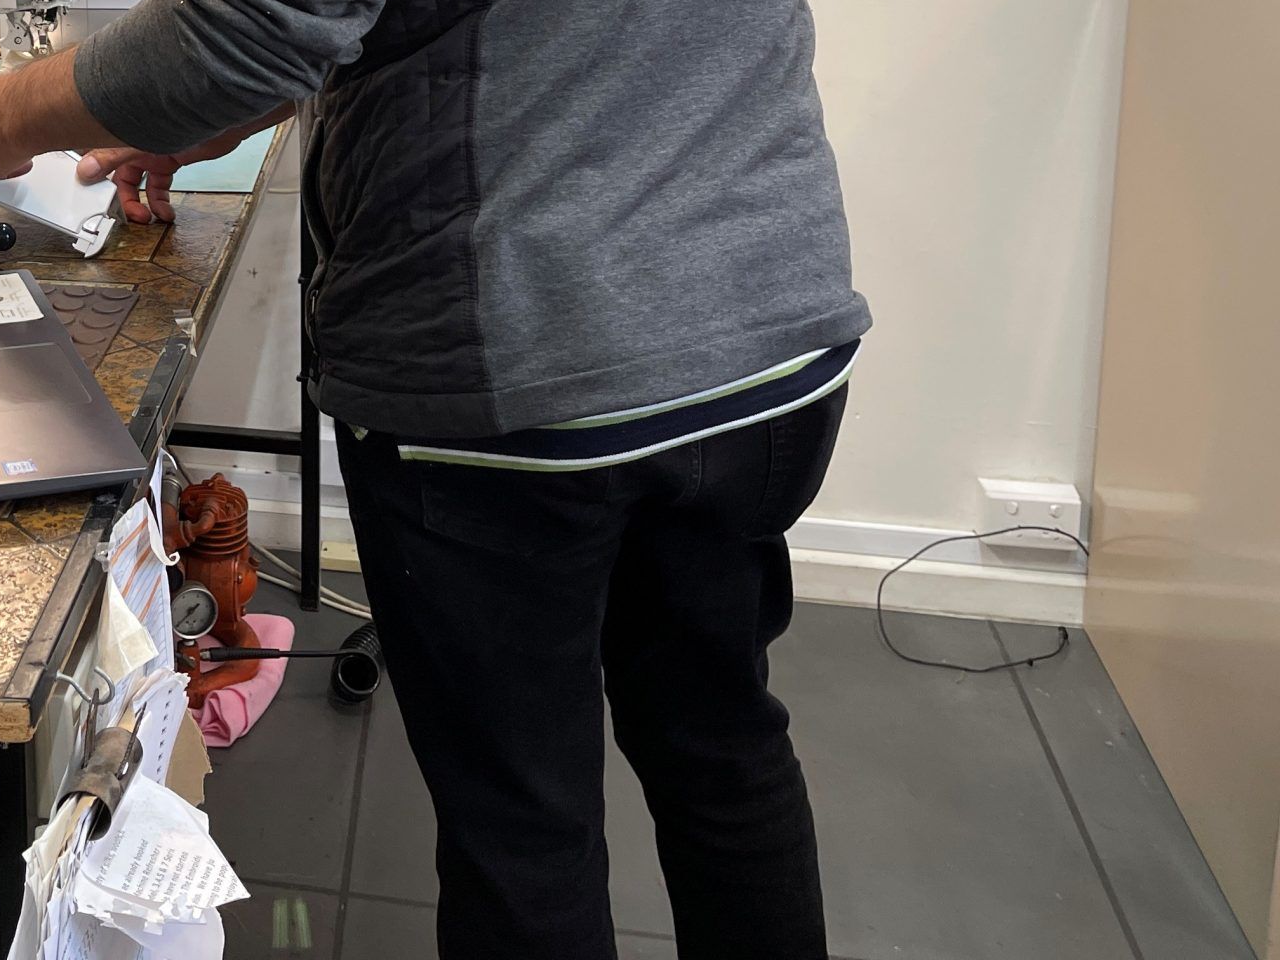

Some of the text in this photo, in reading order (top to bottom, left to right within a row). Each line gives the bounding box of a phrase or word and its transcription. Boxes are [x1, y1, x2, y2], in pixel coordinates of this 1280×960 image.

[125, 860, 140, 882] already
[134, 839, 148, 860] booked
[202, 866, 212, 880] have
